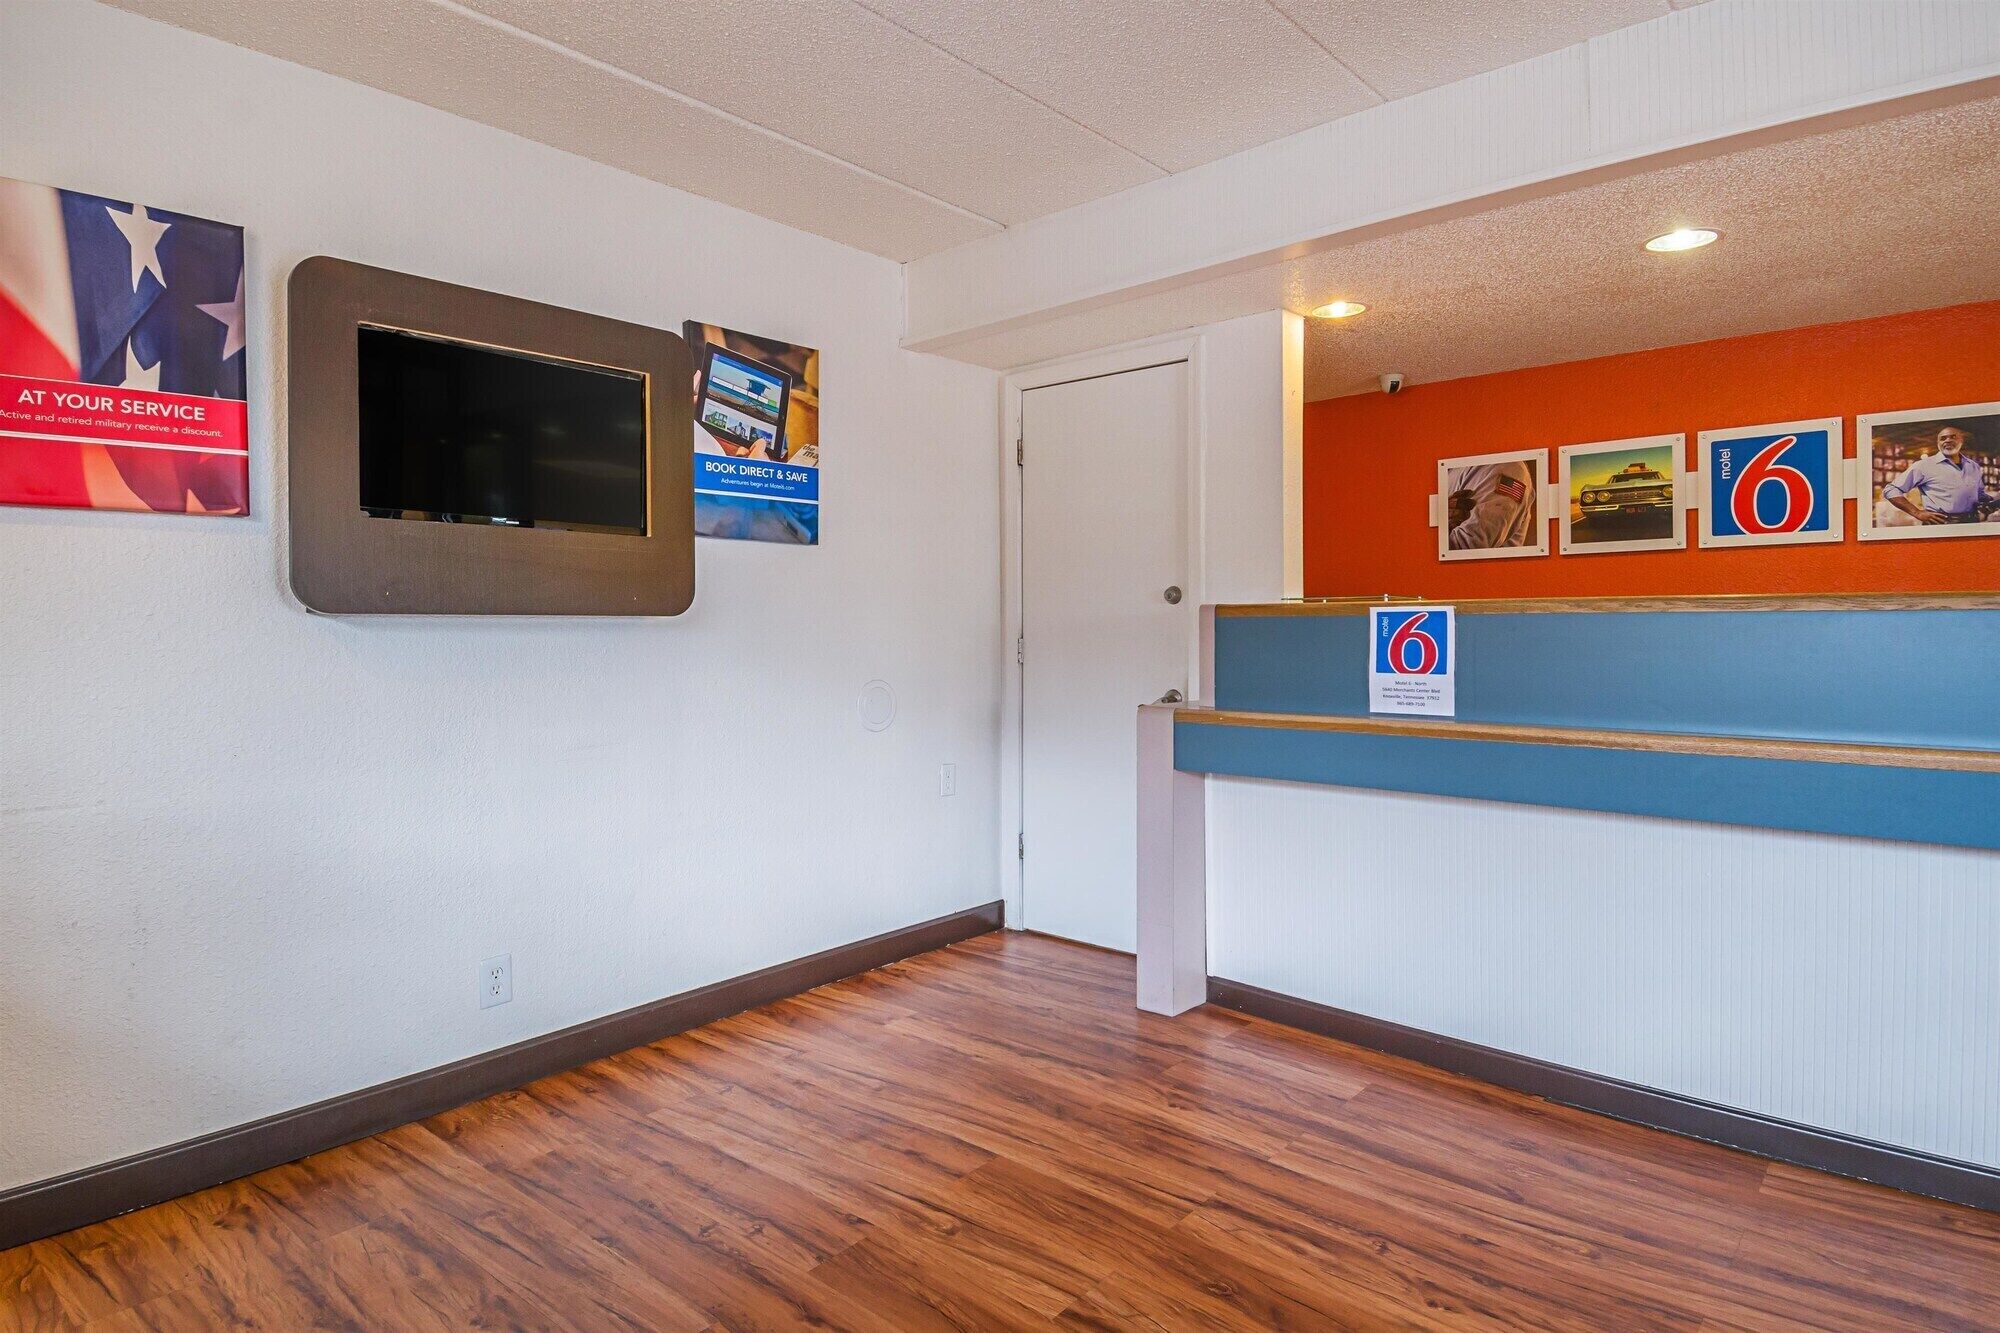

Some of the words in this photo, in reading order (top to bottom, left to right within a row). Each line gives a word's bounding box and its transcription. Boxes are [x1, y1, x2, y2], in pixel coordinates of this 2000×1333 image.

[18, 389, 47, 405] AT
[52, 392, 114, 412] YOUR
[120, 399, 206, 421] SERVICE
[0, 409, 31, 420] Active
[35, 412, 55, 422] and
[58, 415, 92, 426] retired
[95, 418, 131, 431] military
[135, 423, 169, 433] receive
[181, 426, 223, 438] discount.
[705, 461, 737, 475] BOOK
[739, 465, 774, 478] DIRECT
[776, 469, 784, 479] &
[785, 471, 808, 483] SAVE
[720, 478, 749, 486] Adventures
[749, 480, 763, 489] begin
[1719, 448, 1731, 480] motel
[1731, 435, 1814, 535] 6
[1388, 612, 1439, 675] 6
